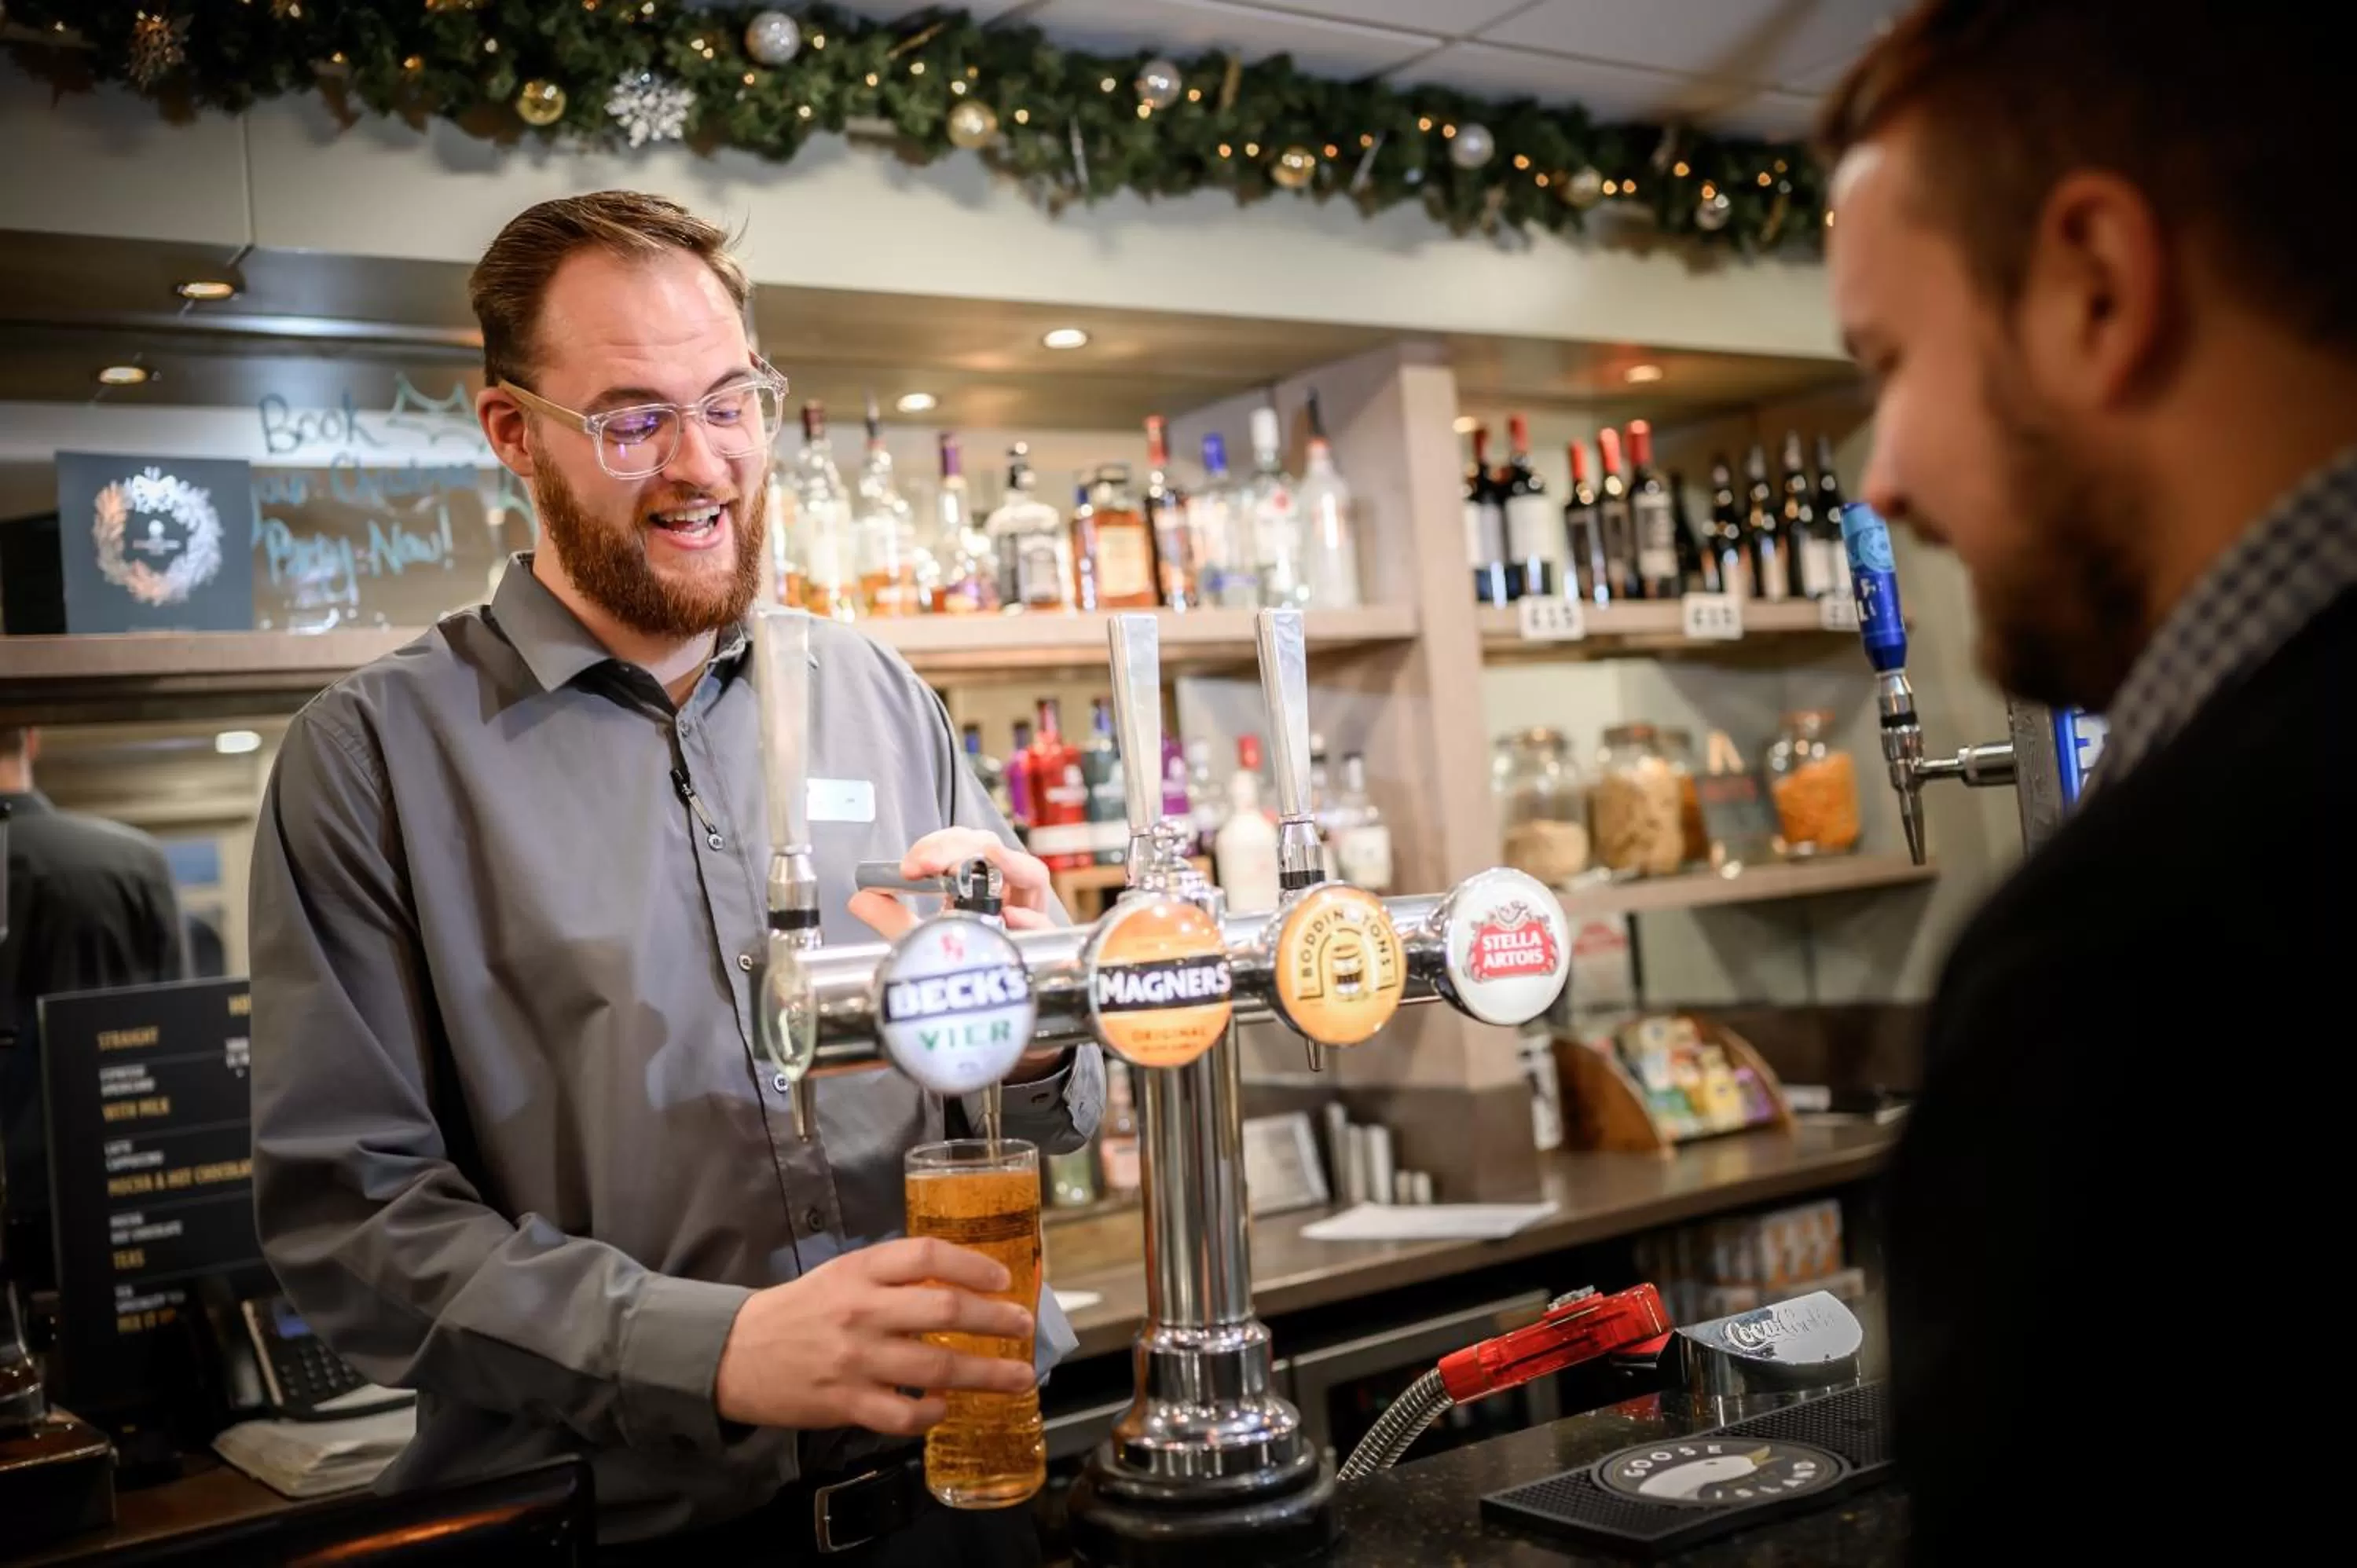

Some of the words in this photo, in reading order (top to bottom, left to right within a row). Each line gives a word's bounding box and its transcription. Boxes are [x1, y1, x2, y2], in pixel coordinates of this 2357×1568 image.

[258, 387, 389, 453] Book
[1300, 909, 1391, 978] BODDINTONS
[1482, 930, 1543, 951] STELLA
[1483, 948, 1545, 969] ARTOIS
[1098, 961, 1233, 1004] MAGNERS
[918, 1020, 1011, 1050] VIER
[1623, 1444, 1723, 1478] GOOSE
